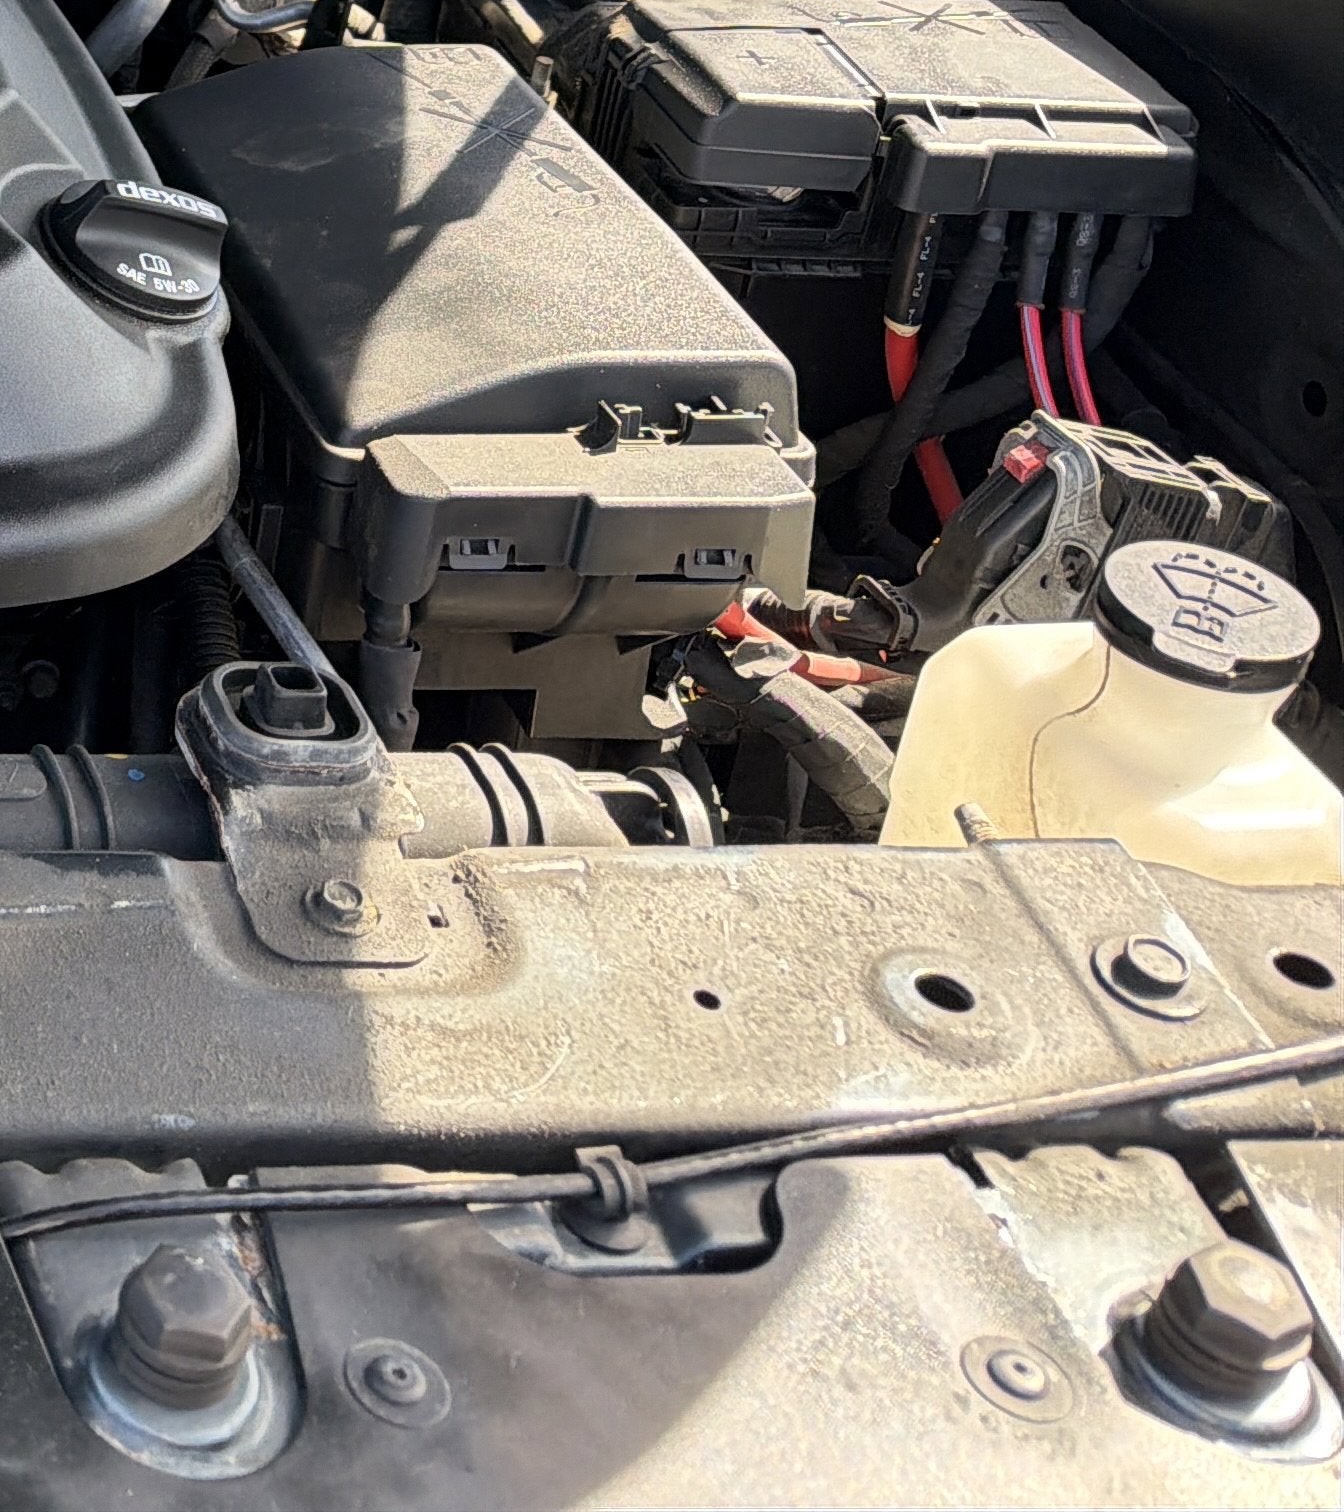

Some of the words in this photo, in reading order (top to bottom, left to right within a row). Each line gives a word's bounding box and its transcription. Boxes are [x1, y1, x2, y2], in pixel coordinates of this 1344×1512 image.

[116, 179, 219, 219] dexos
[116, 261, 148, 287] SAE
[153, 276, 201, 294] 5W-30
